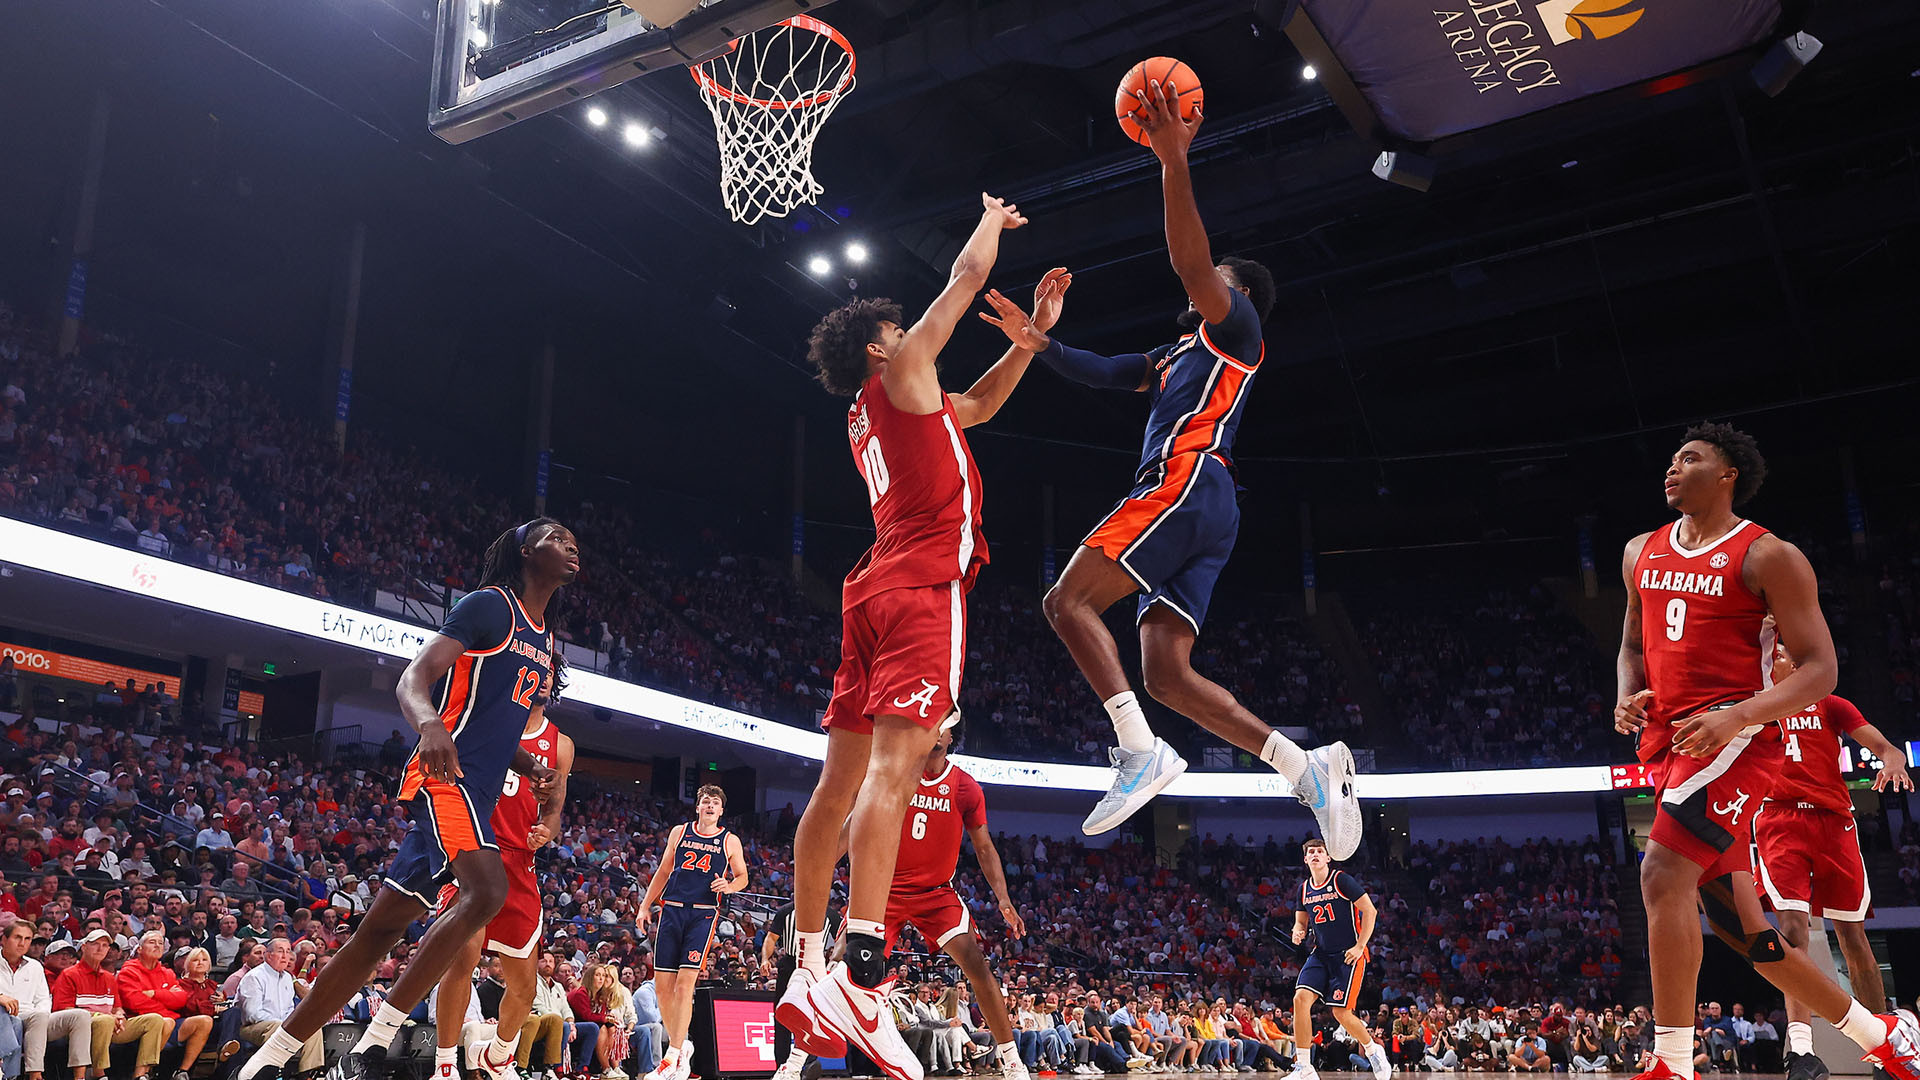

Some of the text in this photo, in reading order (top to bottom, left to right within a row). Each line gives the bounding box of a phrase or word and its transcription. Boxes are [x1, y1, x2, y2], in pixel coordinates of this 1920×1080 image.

[1432, 9, 1503, 94] ARENA
[1467, 0, 1561, 94] EGACY
[861, 435, 890, 508] 10
[1711, 553, 1728, 567] SEC
[1640, 569, 1724, 596] ALABAMA
[321, 611, 356, 637] EAT
[359, 623, 395, 649] MOR
[1665, 598, 1687, 642] 9
[511, 665, 541, 710] 12
[893, 678, 940, 718] A
[1785, 733, 1803, 762] 4
[502, 768, 521, 797] 5
[1712, 787, 1750, 825] A
[911, 811, 928, 841] 6
[680, 840, 722, 855] AUBURN
[681, 851, 712, 873] 24
[1304, 891, 1339, 905] AUBURN
[1312, 902, 1336, 924] 21
